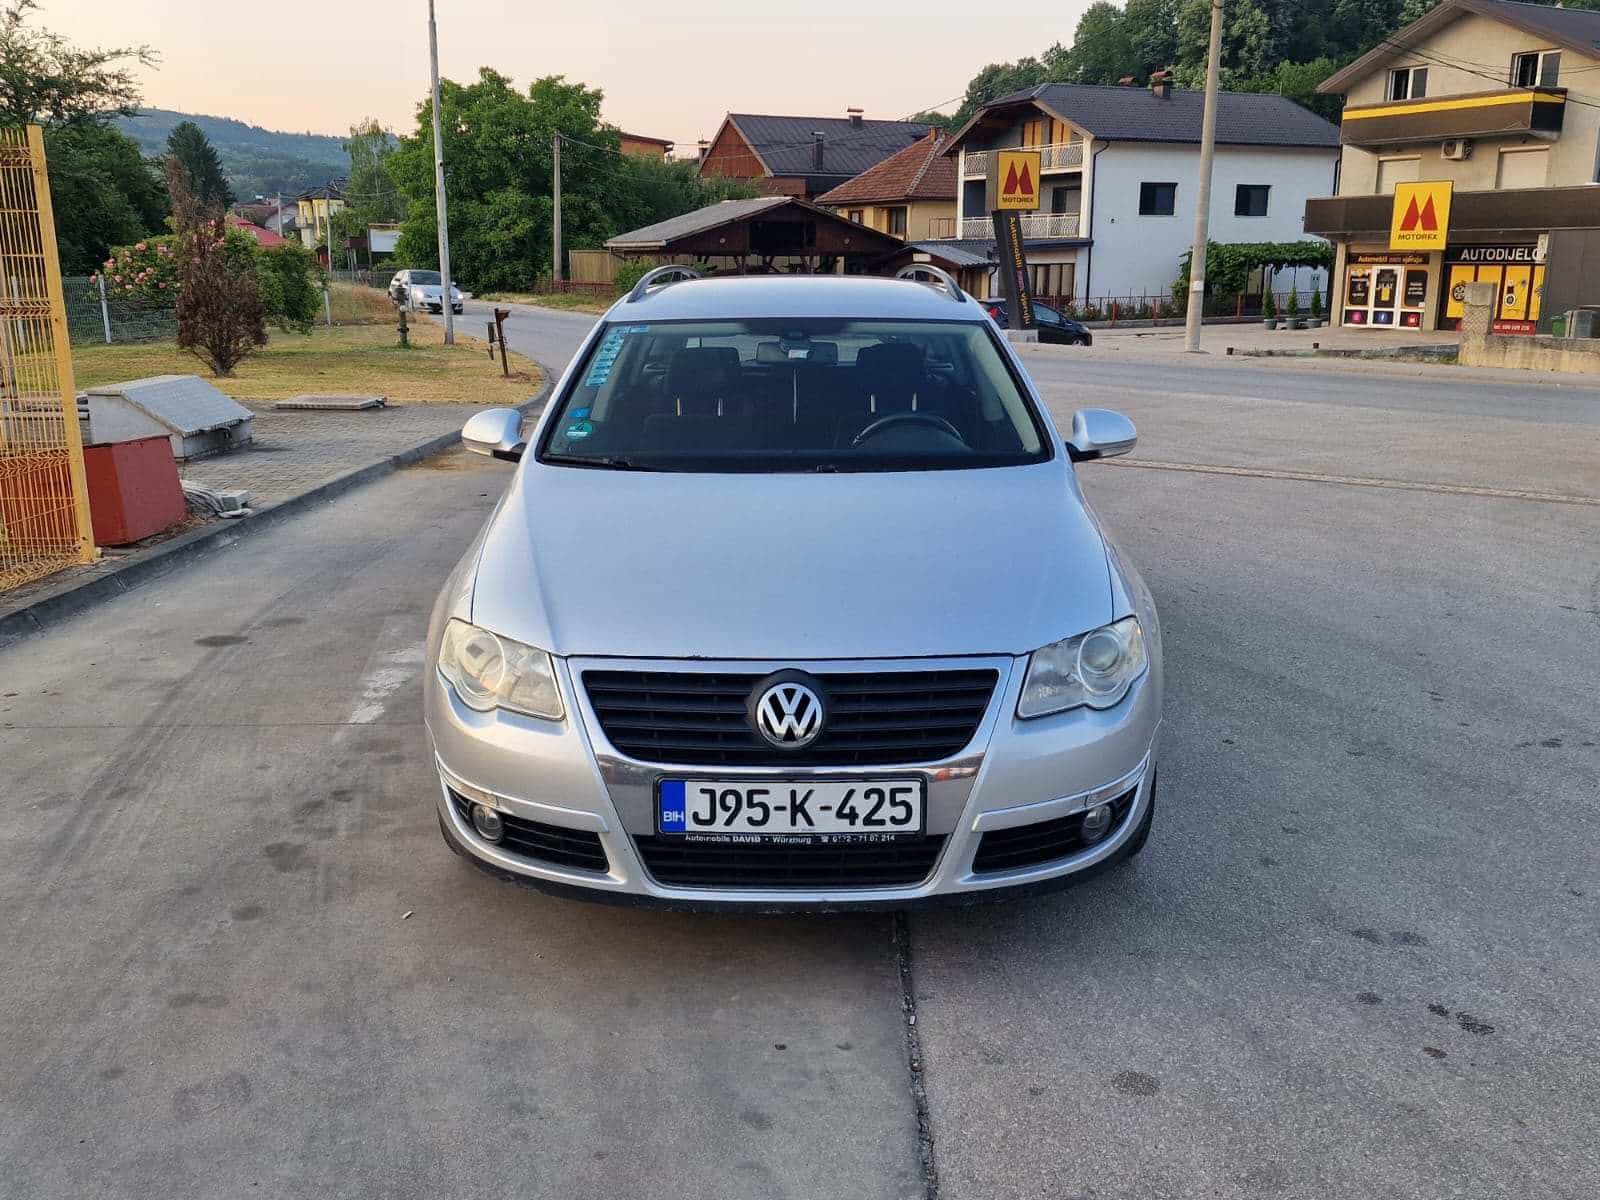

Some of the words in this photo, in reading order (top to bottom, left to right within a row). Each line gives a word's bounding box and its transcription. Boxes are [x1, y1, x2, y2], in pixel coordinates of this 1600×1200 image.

[1397, 233, 1438, 241] MOTOREX
[691, 787, 914, 827] J95-K-425
[662, 811, 685, 823] BIH
